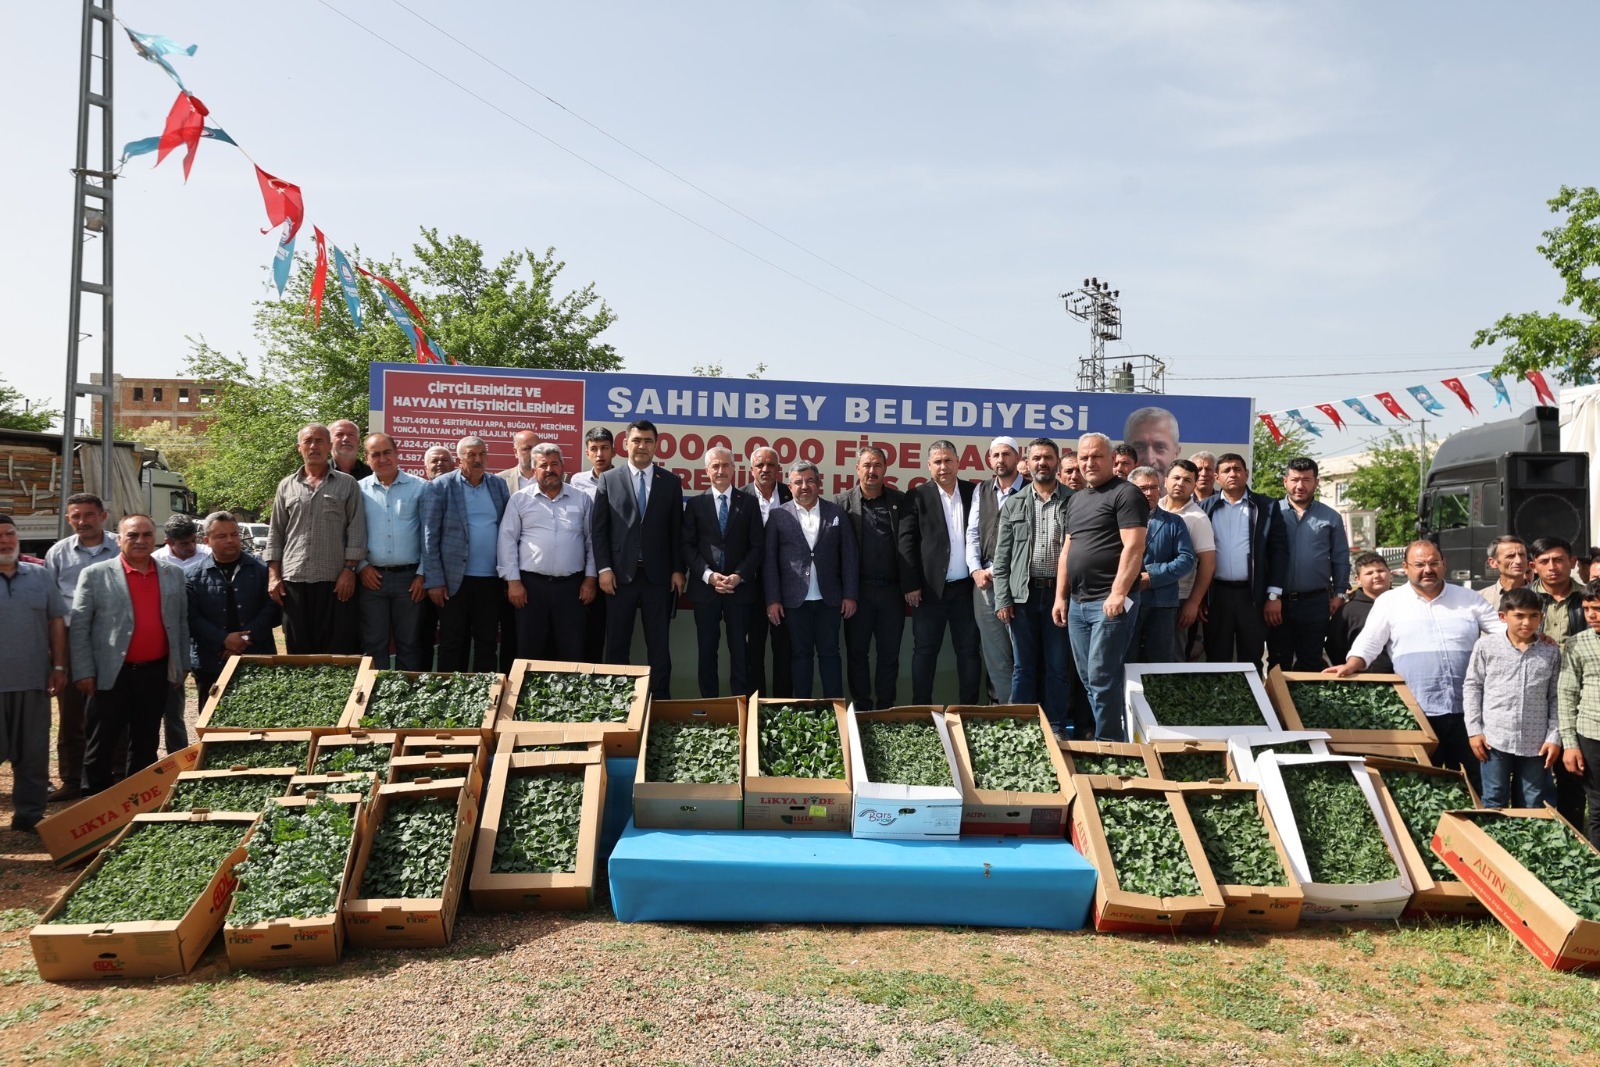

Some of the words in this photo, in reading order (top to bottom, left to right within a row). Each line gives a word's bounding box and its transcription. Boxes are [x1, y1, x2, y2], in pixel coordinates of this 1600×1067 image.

[428, 381, 523, 397] ÇİFTÇİLERİMİZE
[525, 387, 541, 398] VE
[393, 396, 447, 409] HAYVAN
[450, 398, 575, 415] YETİŞTİRİCİLERİMİZE
[393, 416, 429, 425] 16.571.400
[442, 418, 485, 428] SERTİFİKALI
[485, 420, 506, 429] ARPA,
[507, 420, 538, 430] BUĞDAY,
[540, 422, 578, 433] MERCİMEK,
[393, 425, 420, 435] YONCA,
[420, 425, 451, 435] İTALYAN
[478, 428, 509, 438] SİLAJLIK
[836, 434, 922, 469] FİDE
